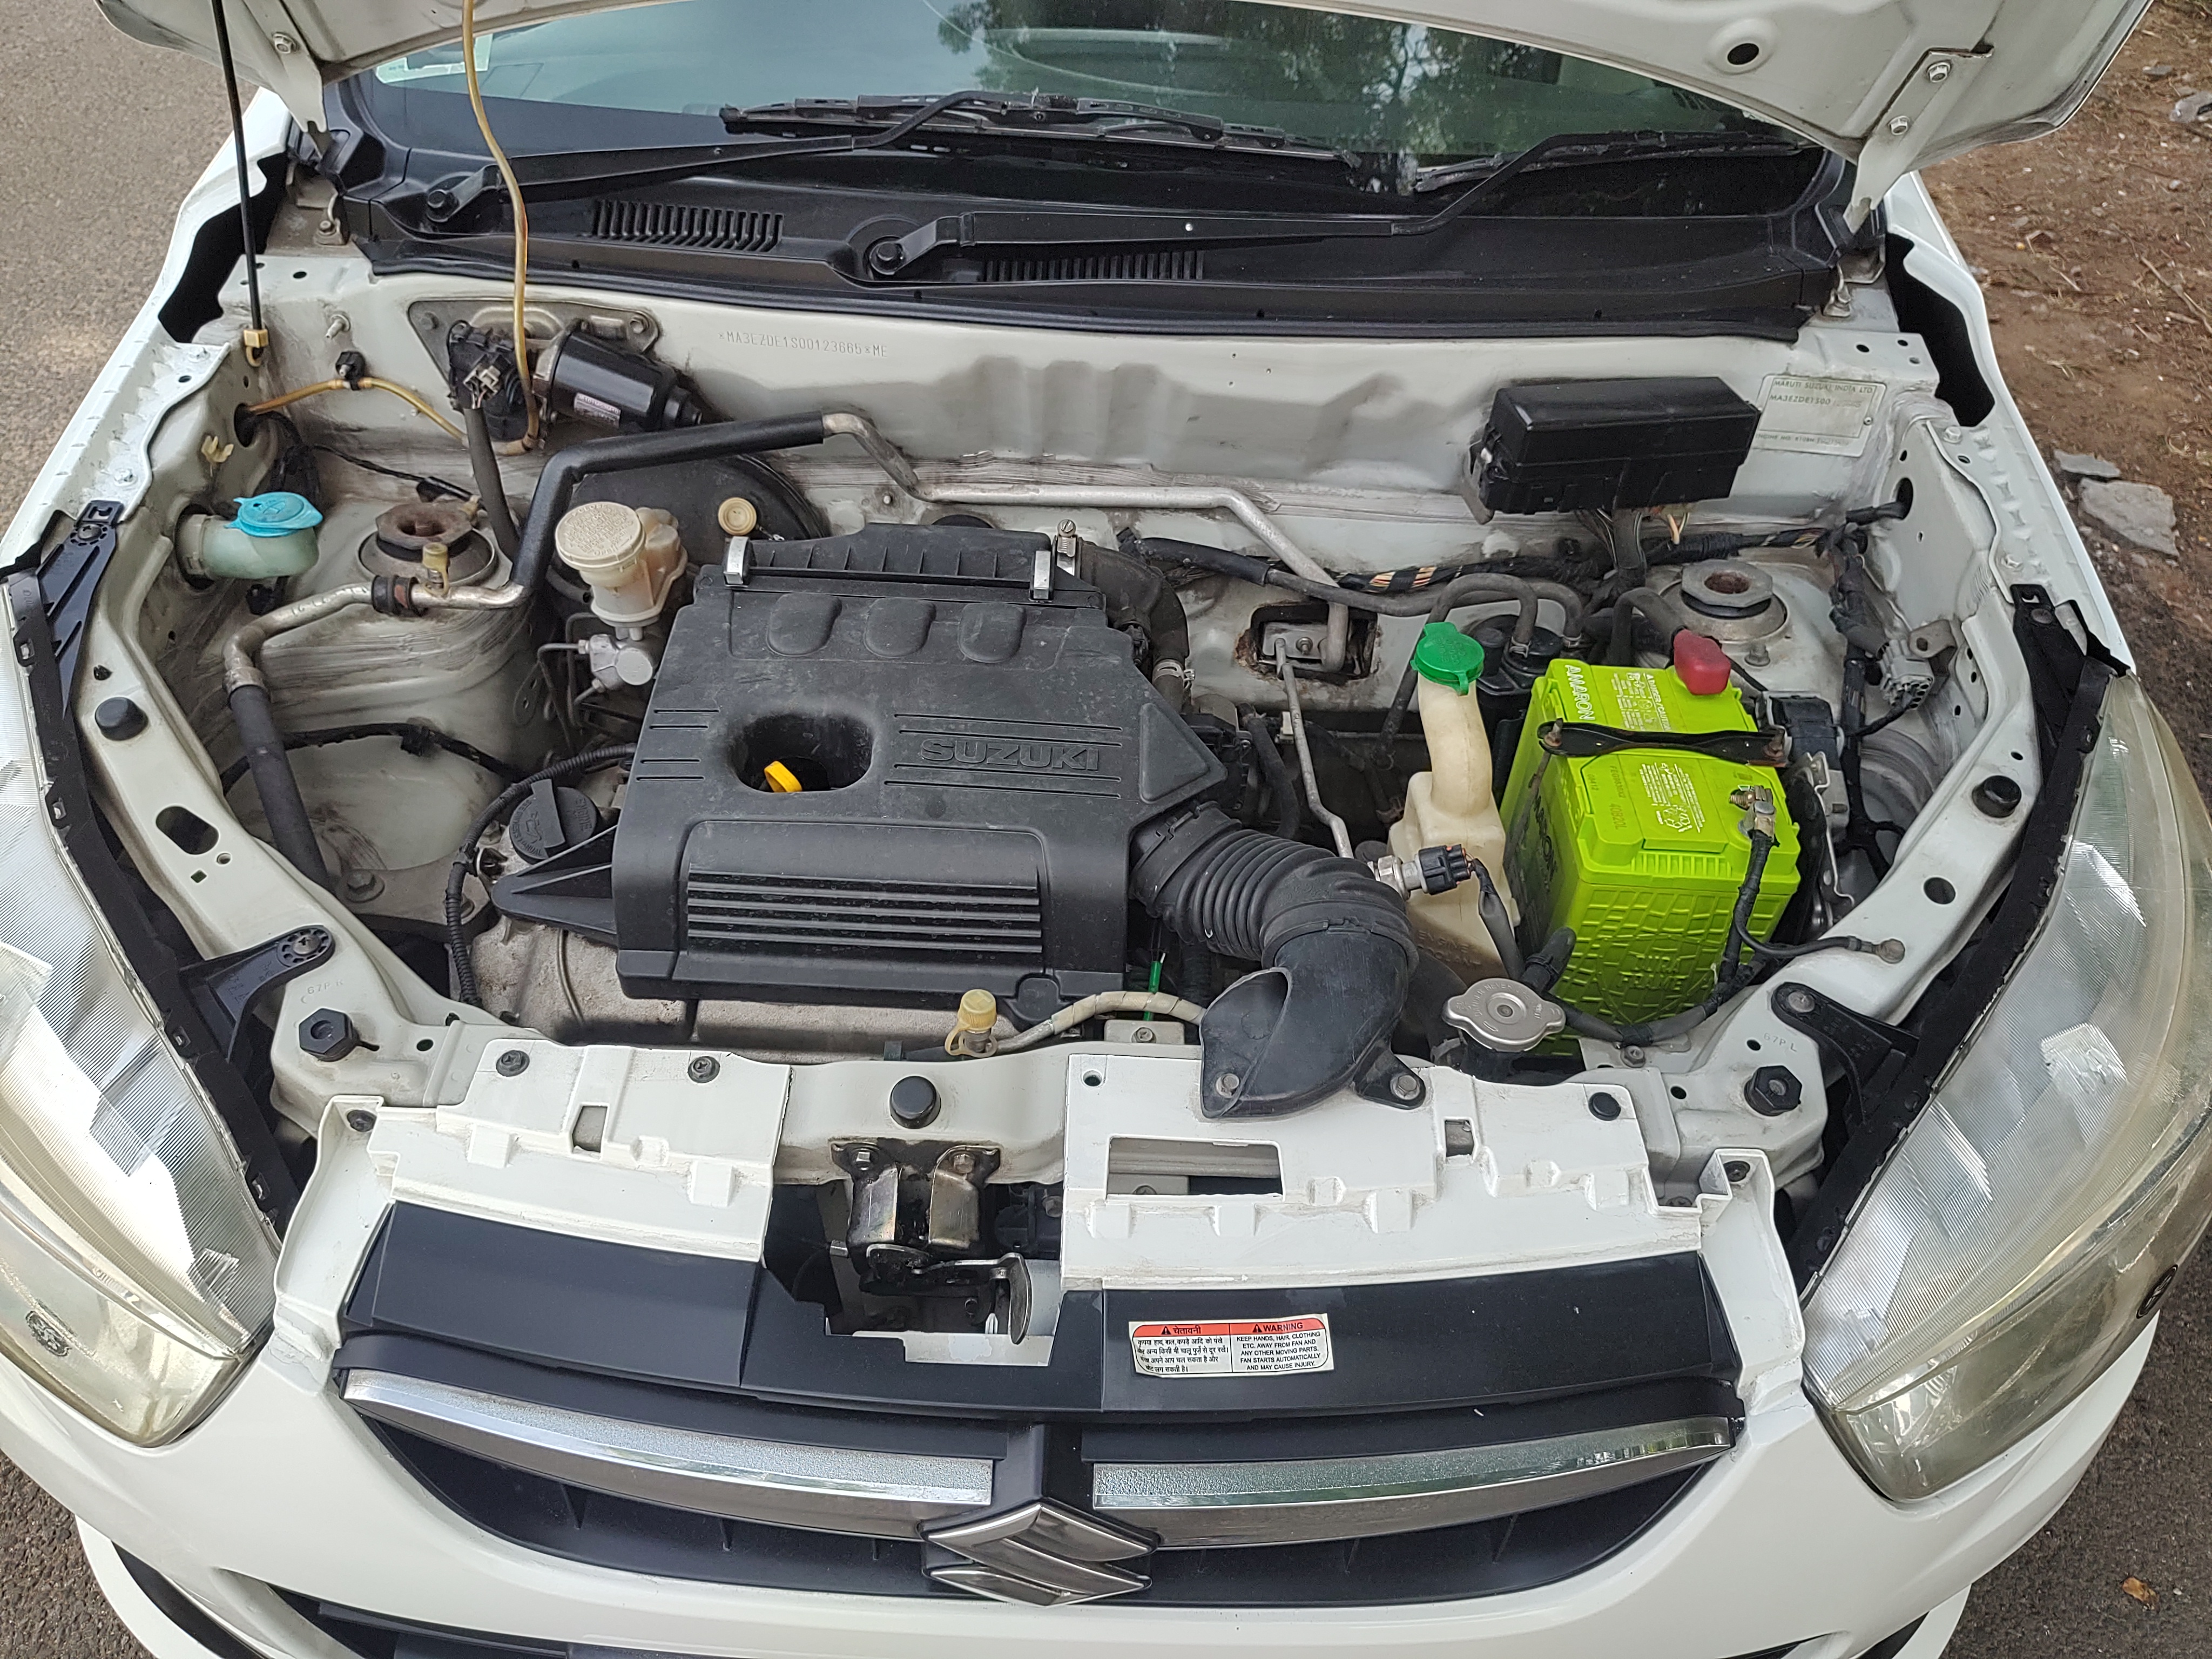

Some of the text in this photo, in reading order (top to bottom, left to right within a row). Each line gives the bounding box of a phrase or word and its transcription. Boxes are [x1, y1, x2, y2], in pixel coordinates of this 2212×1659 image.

[1805, 383, 1832, 391] SUZUKI
[578, 504, 607, 514] CLOSE
[1565, 665, 1595, 720] AMARON
[921, 738, 1100, 771] SUZUKI
[1609, 802, 1626, 830] 40B20L
[1418, 930, 1469, 954] ENGINE
[1484, 983, 1513, 993] NEVER
[1764, 1033, 1797, 1052] 67P L
[1173, 1325, 1201, 1334] चेतावनी
[1263, 1322, 1303, 1332] WARNING
[1138, 1339, 1152, 1347] कृपया
[1159, 1346, 1172, 1354] किसी
[1180, 1347, 1192, 1355] चालू
[1276, 1353, 1321, 1362] AUTOMATICALLY
